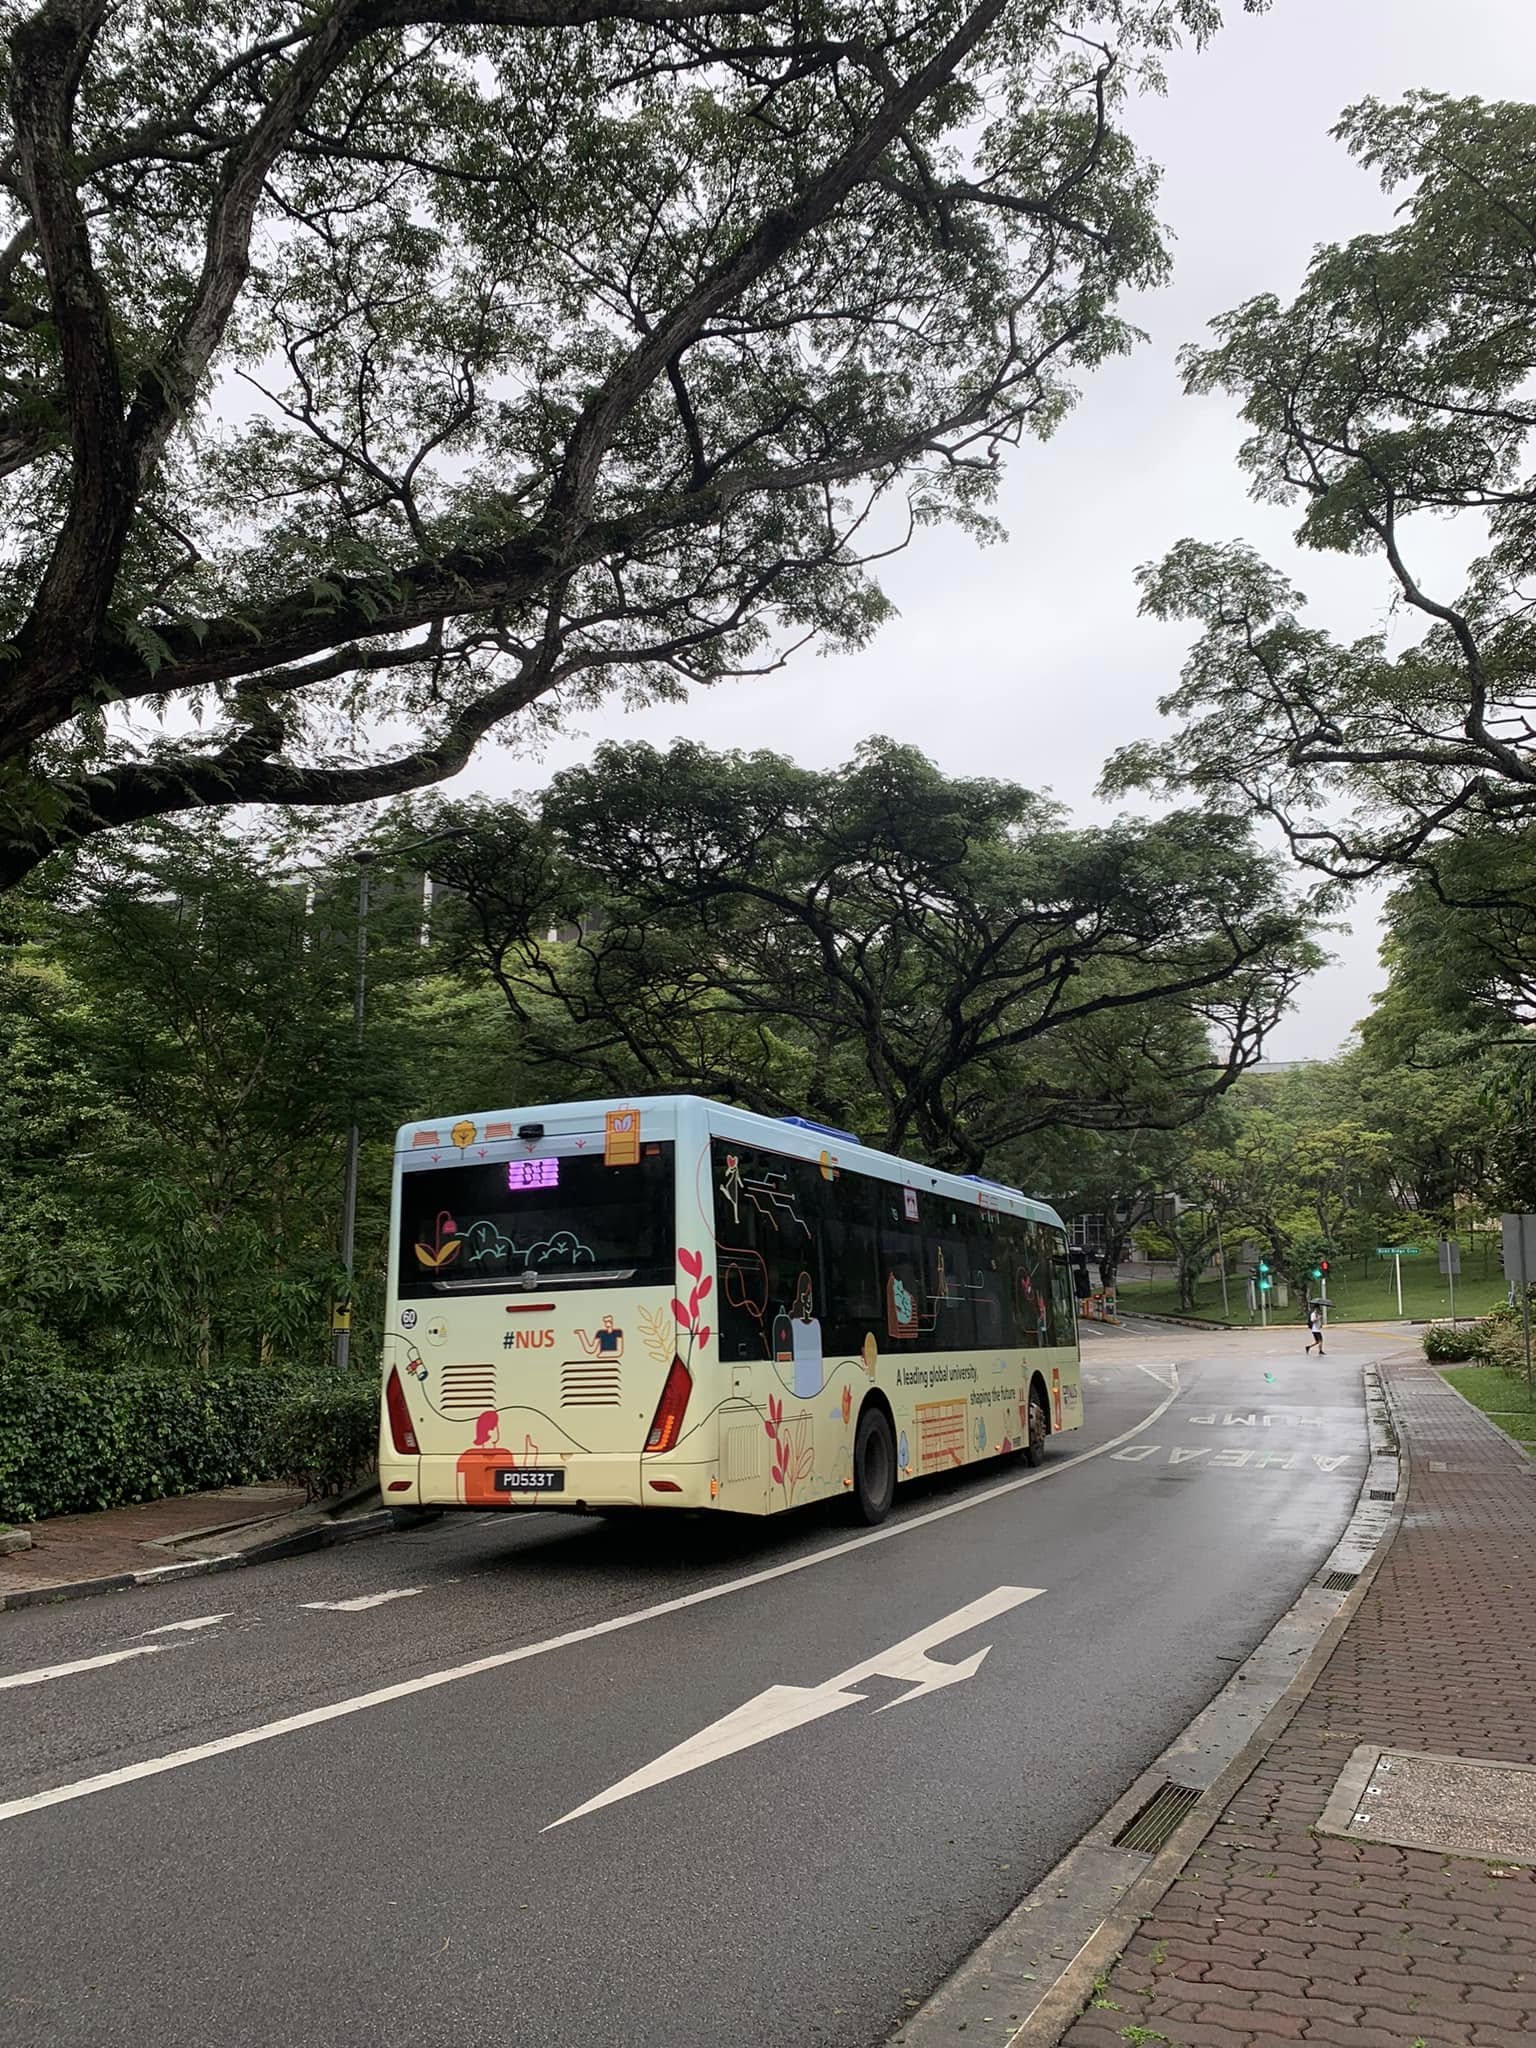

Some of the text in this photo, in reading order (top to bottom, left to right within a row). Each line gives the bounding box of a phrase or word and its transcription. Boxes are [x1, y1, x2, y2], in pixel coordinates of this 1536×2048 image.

[403, 1311, 415, 1323] 60
[503, 1329, 555, 1349] #NUS
[896, 1369, 902, 1386] A
[903, 1366, 928, 1388] leading
[929, 1364, 948, 1387] global
[970, 1385, 1016, 1407] shaping the future
[1109, 1446, 1351, 1472] AHEAD
[503, 1473, 555, 1486] PD533T
